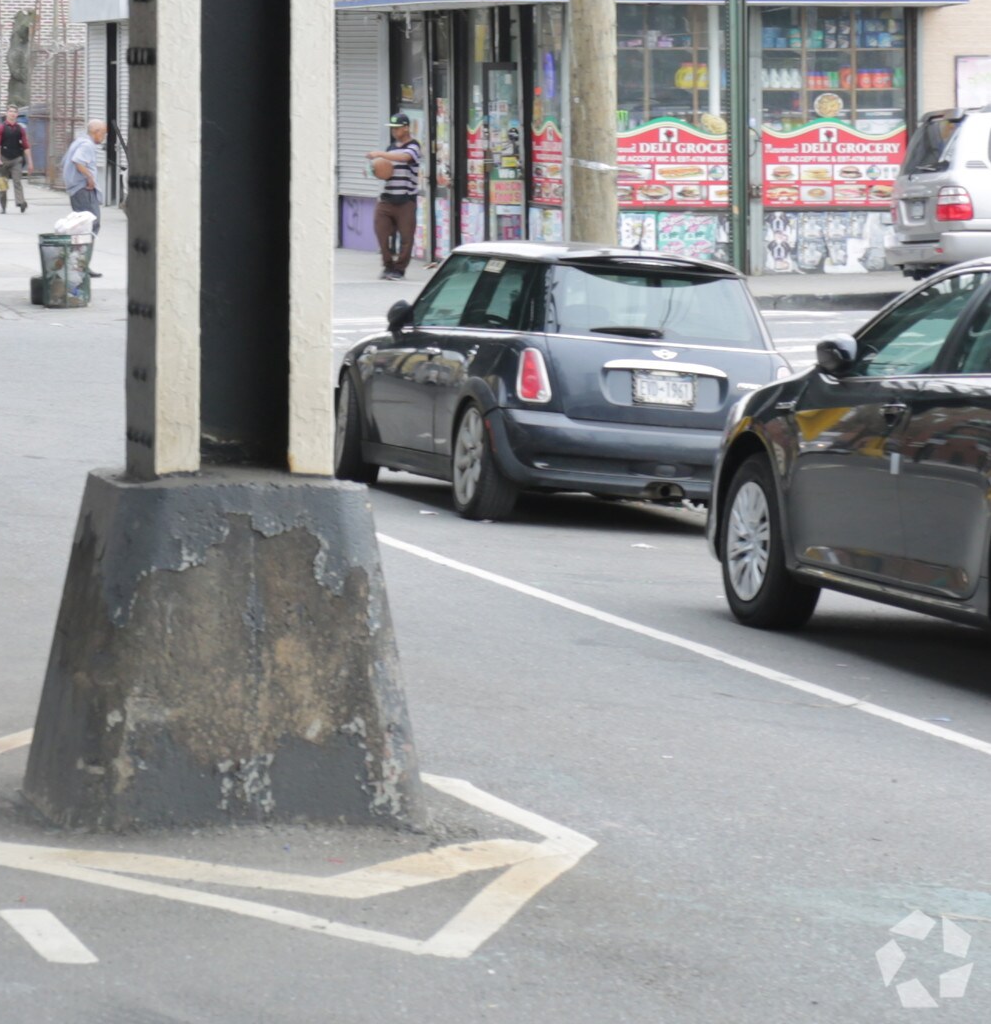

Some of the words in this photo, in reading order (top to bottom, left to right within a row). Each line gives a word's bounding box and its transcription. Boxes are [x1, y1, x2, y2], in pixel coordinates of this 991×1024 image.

[639, 143, 672, 154] DELI
[801, 143, 833, 154] DELI
[835, 143, 900, 154] GROCERY
